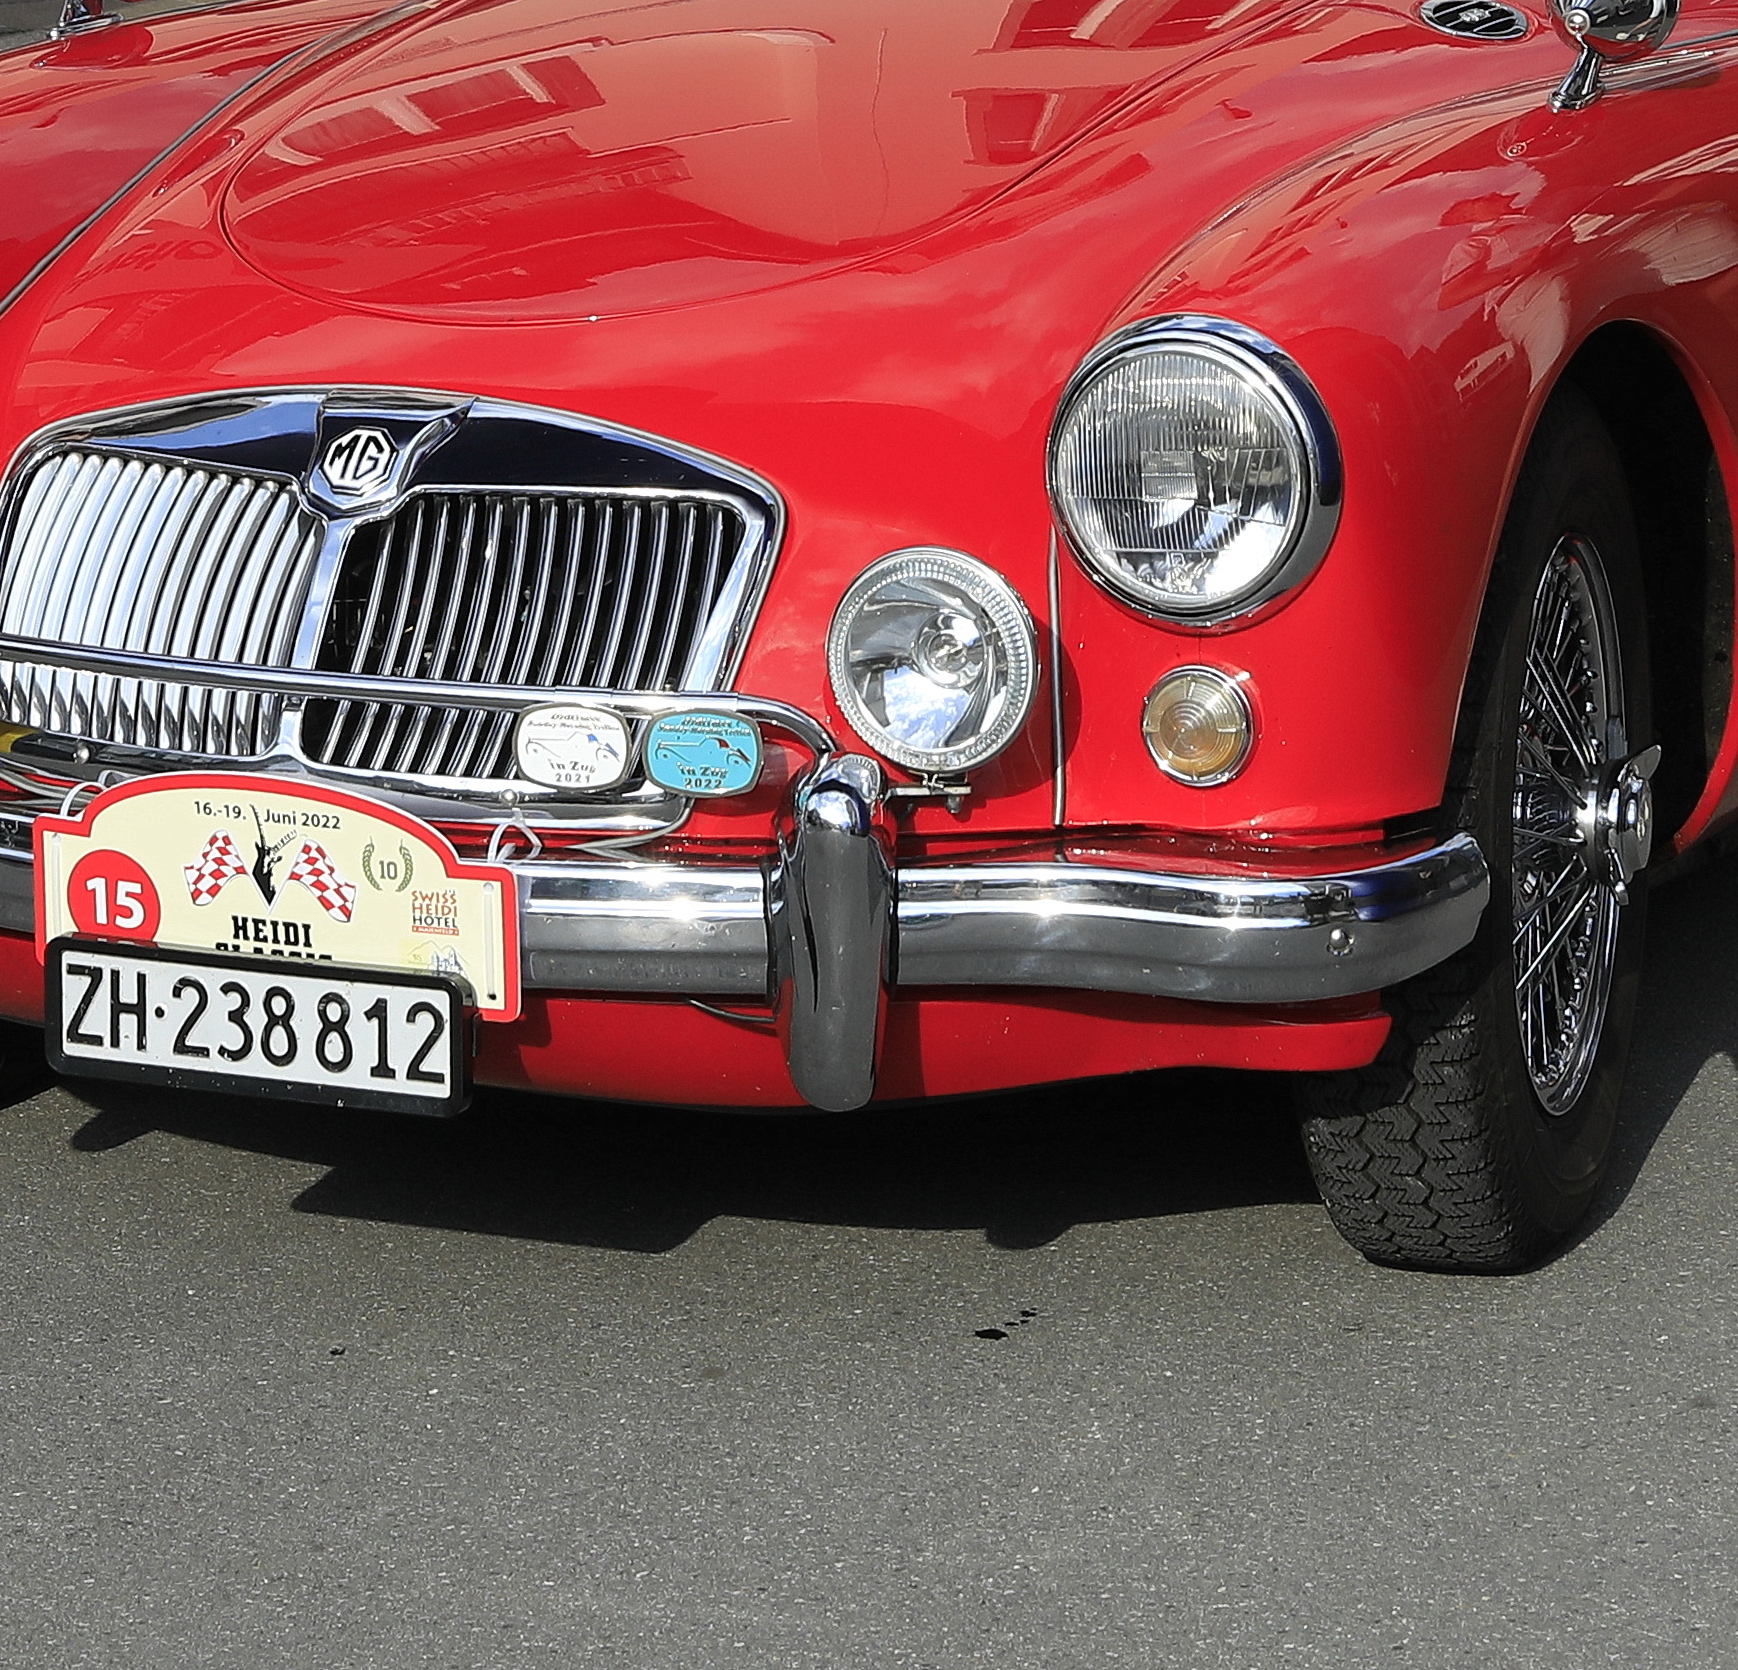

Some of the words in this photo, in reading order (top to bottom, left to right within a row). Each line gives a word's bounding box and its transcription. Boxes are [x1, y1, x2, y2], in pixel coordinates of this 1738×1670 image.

[328, 433, 386, 481] MG
[548, 759, 566, 770] in
[569, 760, 596, 774] Zug
[677, 762, 696, 776] in
[700, 765, 728, 779] Zug
[555, 772, 591, 784] 2021
[685, 777, 722, 789] 2022
[194, 801, 247, 821] 16.-19.
[263, 808, 297, 827] Juni
[301, 812, 341, 830] 2022
[378, 860, 398, 880] 10
[85, 876, 146, 929] 15
[411, 890, 457, 906] SWISS
[412, 902, 457, 918] HEIDI
[412, 915, 458, 928] HOTEL
[231, 915, 313, 948] HEIDI
